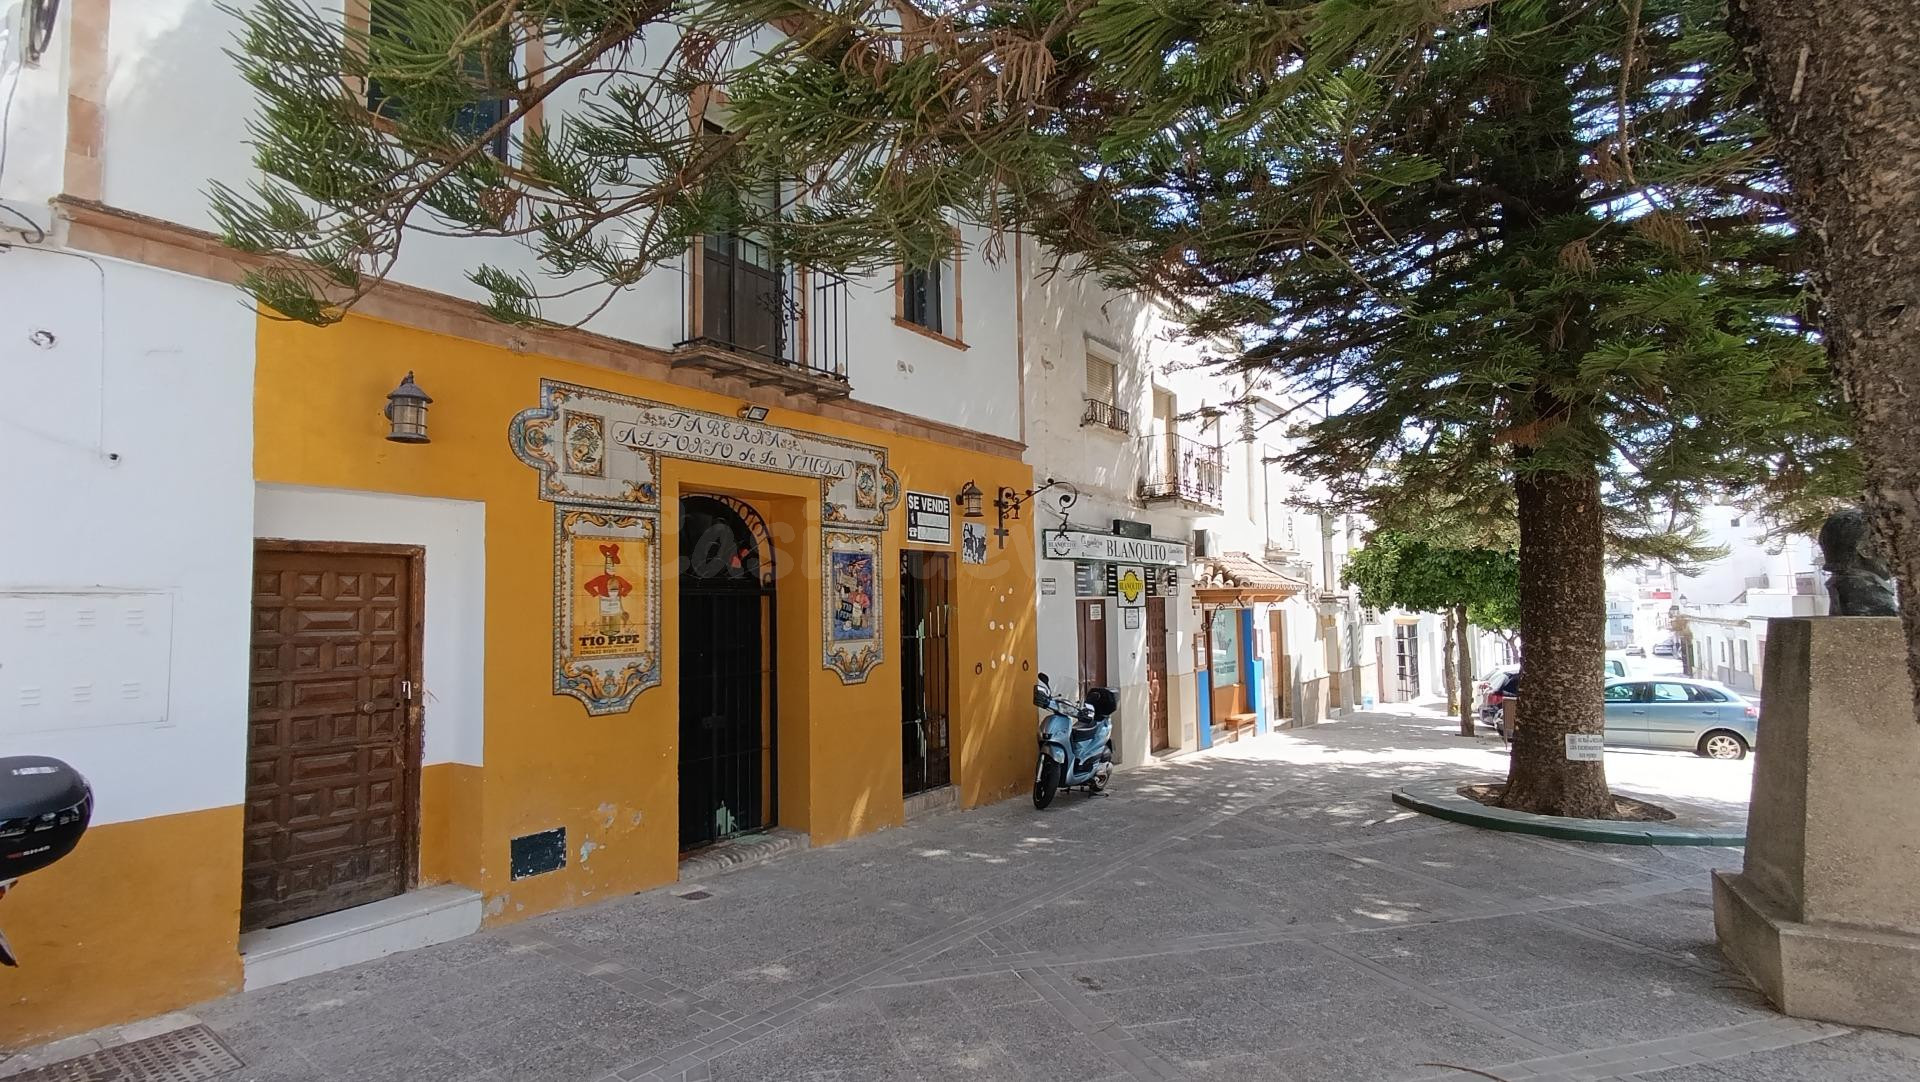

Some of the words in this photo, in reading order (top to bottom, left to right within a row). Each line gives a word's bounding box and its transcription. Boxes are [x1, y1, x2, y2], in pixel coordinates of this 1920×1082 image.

[667, 412, 780, 448] TABERNA
[615, 426, 734, 459] ALFONSO
[739, 447, 756, 463] de
[787, 452, 846, 477] VIUDA
[908, 494, 920, 510] SE
[921, 496, 950, 514] VENDE
[1106, 539, 1166, 563] BLANQUITO
[1118, 581, 1144, 592] BLANQUITO
[579, 636, 605, 646] TIO
[607, 634, 640, 645] PEPE
